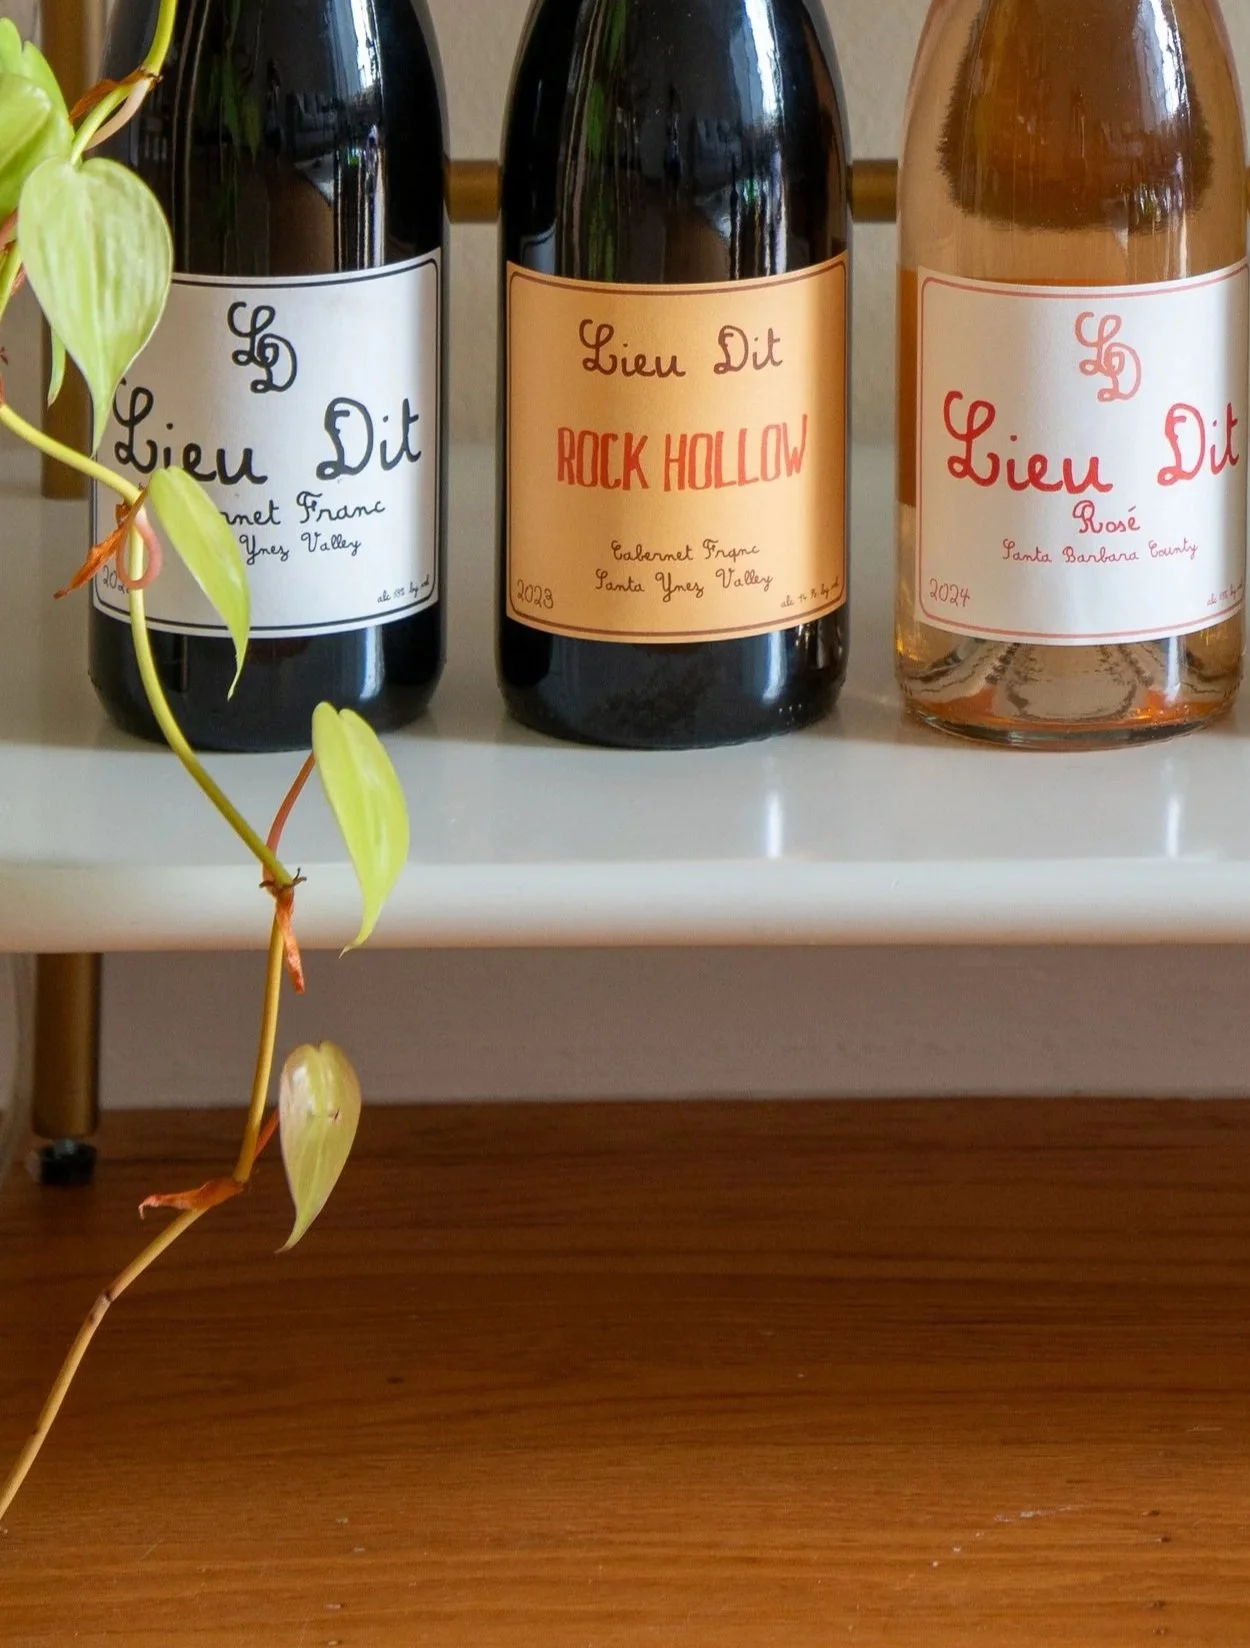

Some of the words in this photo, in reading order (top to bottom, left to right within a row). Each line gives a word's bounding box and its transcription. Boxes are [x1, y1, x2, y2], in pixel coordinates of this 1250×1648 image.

[579, 319, 686, 377] Lieu
[713, 325, 783, 375] Dit
[112, 377, 268, 485] Lieu
[316, 397, 422, 481] Dit
[944, 390, 1113, 494] Lieu
[1157, 402, 1239, 486] Dit
[557, 426, 650, 491] ROCK
[663, 413, 808, 492] HOLLOW
[297, 491, 386, 524] Franc
[1072, 499, 1140, 534] Rosé
[239, 534, 289, 565] Ynez
[301, 532, 361, 556] Valley
[611, 540, 693, 562] Cabernet
[703, 539, 760, 563] Franc
[1002, 539, 1052, 562] Santa
[1062, 546, 1139, 563] Barbara
[1149, 537, 1198, 560] County
[517, 579, 553, 609] 2023
[595, 569, 645, 593] Santa
[655, 572, 704, 603] Ynez
[715, 568, 773, 592] Valley
[929, 578, 971, 607] 2024
